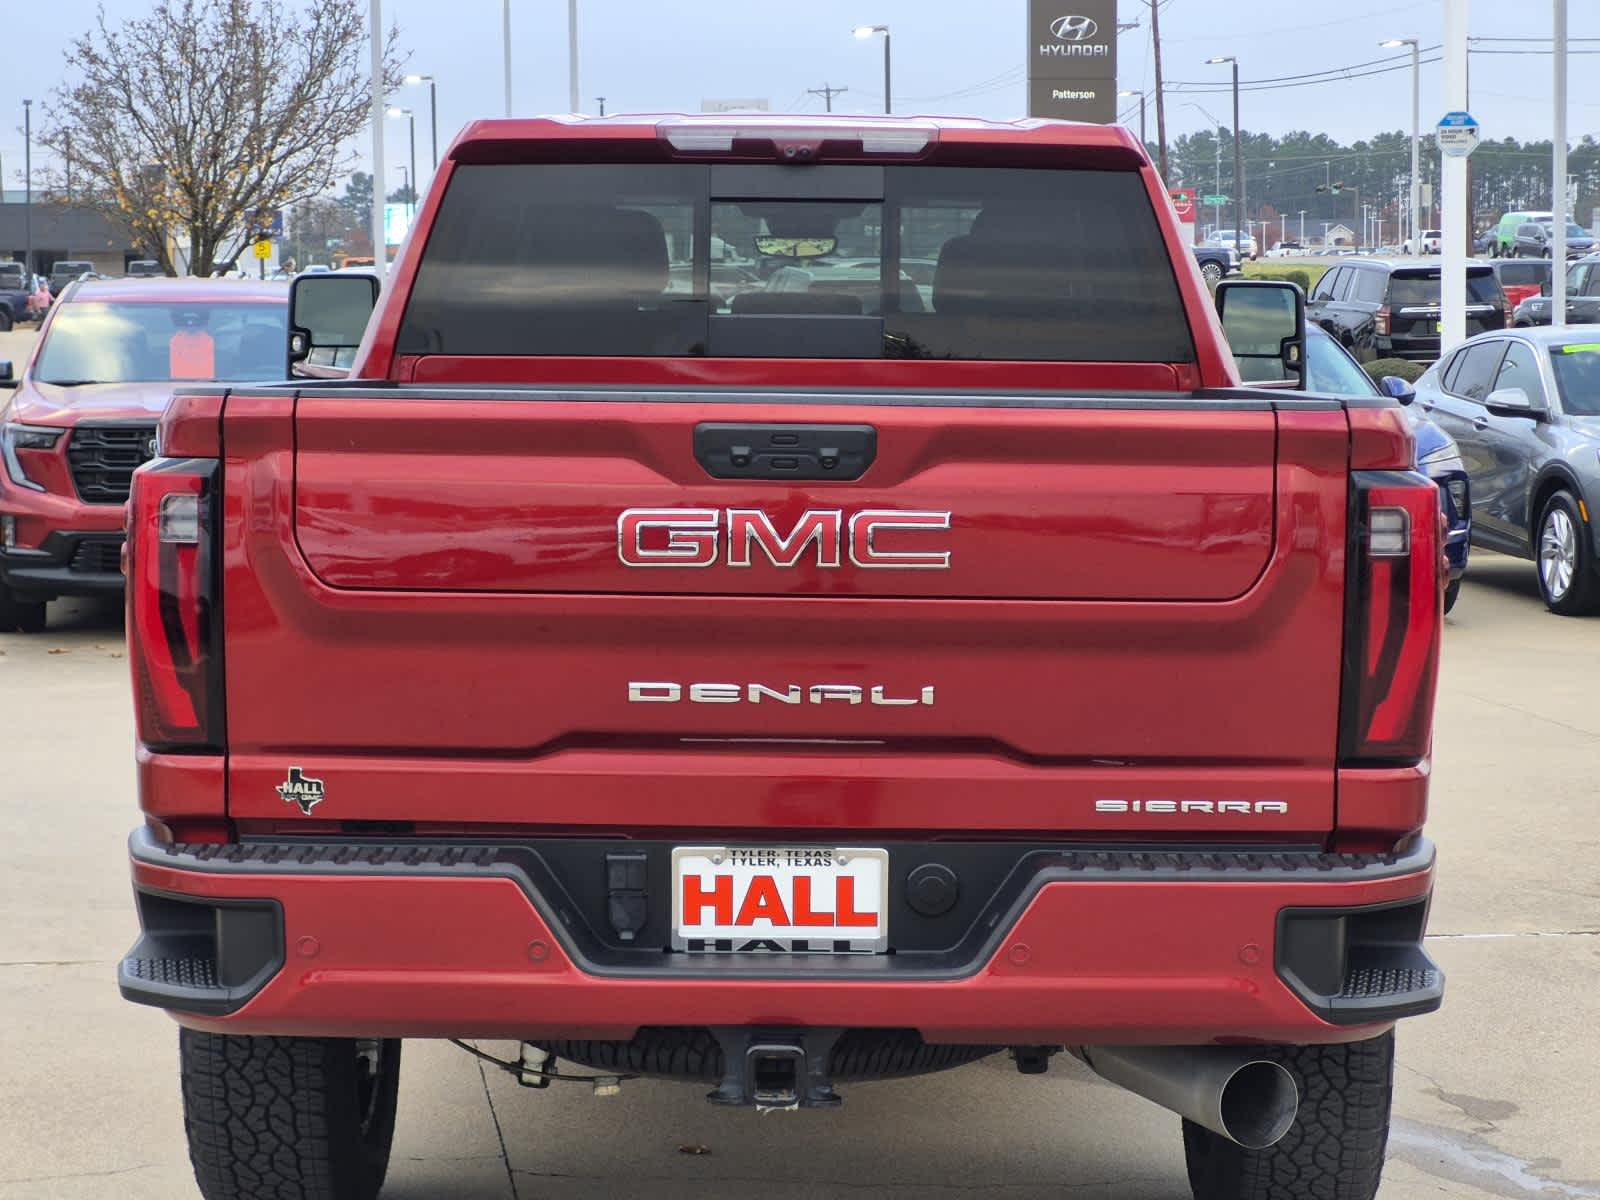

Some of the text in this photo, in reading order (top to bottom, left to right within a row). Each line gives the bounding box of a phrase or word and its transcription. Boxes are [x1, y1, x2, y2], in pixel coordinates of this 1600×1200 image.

[1040, 45, 1108, 56] HYUNDAI
[1052, 89, 1096, 99] Patterson
[617, 508, 951, 569] GMC
[628, 681, 934, 705] DENALI
[283, 782, 321, 794] HALL
[1095, 799, 1288, 814] SIERRA
[785, 849, 832, 858] TEXAS
[786, 857, 832, 867] TEXAS
[682, 874, 878, 927] HALL
[687, 938, 873, 953] HALL
